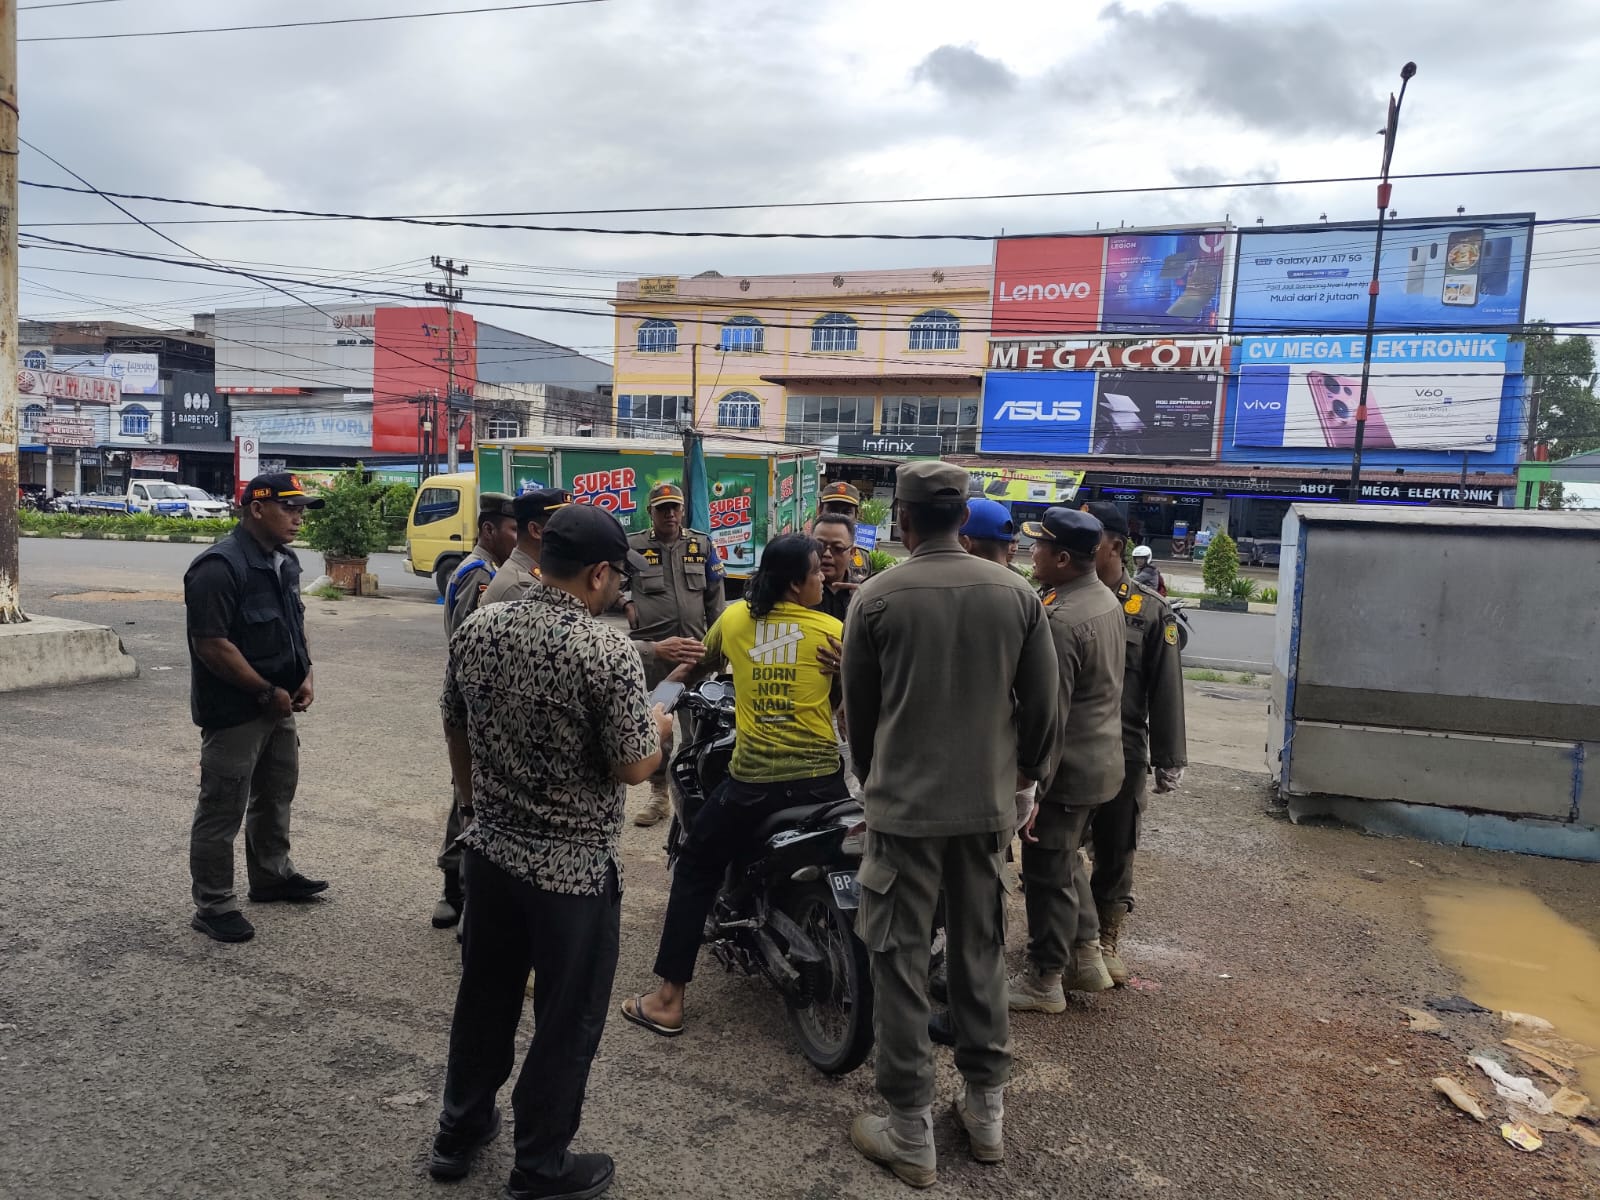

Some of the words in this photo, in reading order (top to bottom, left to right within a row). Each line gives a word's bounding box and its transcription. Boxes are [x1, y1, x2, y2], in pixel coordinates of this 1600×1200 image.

[1276, 256, 1310, 266] Galaxy
[1311, 255, 1327, 264] A17
[1331, 254, 1346, 263] A17
[1348, 254, 1362, 262] 5G
[999, 281, 1091, 302] Lenovo
[1270, 293, 1296, 302] Mulai
[1296, 292, 1317, 301] dari
[1319, 293, 1325, 301] 2
[1325, 292, 1360, 303] jutaan
[991, 344, 1223, 369] MEGACOM
[1249, 342, 1278, 359] CV
[1282, 341, 1343, 359] MEGA
[39, 373, 117, 402] YAMAHA
[1415, 388, 1443, 397] V60
[993, 400, 1082, 422] ASUS
[1243, 400, 1281, 410] vivo
[178, 414, 215, 424] BARBETRO
[862, 439, 915, 453] Infinix
[573, 467, 636, 496] SUPER
[1361, 484, 1400, 497] MEGA
[709, 496, 751, 515] SUPER
[710, 509, 751, 529] SOL
[752, 667, 797, 682] BORN
[752, 698, 795, 711] MADE
[834, 875, 852, 891] BP
